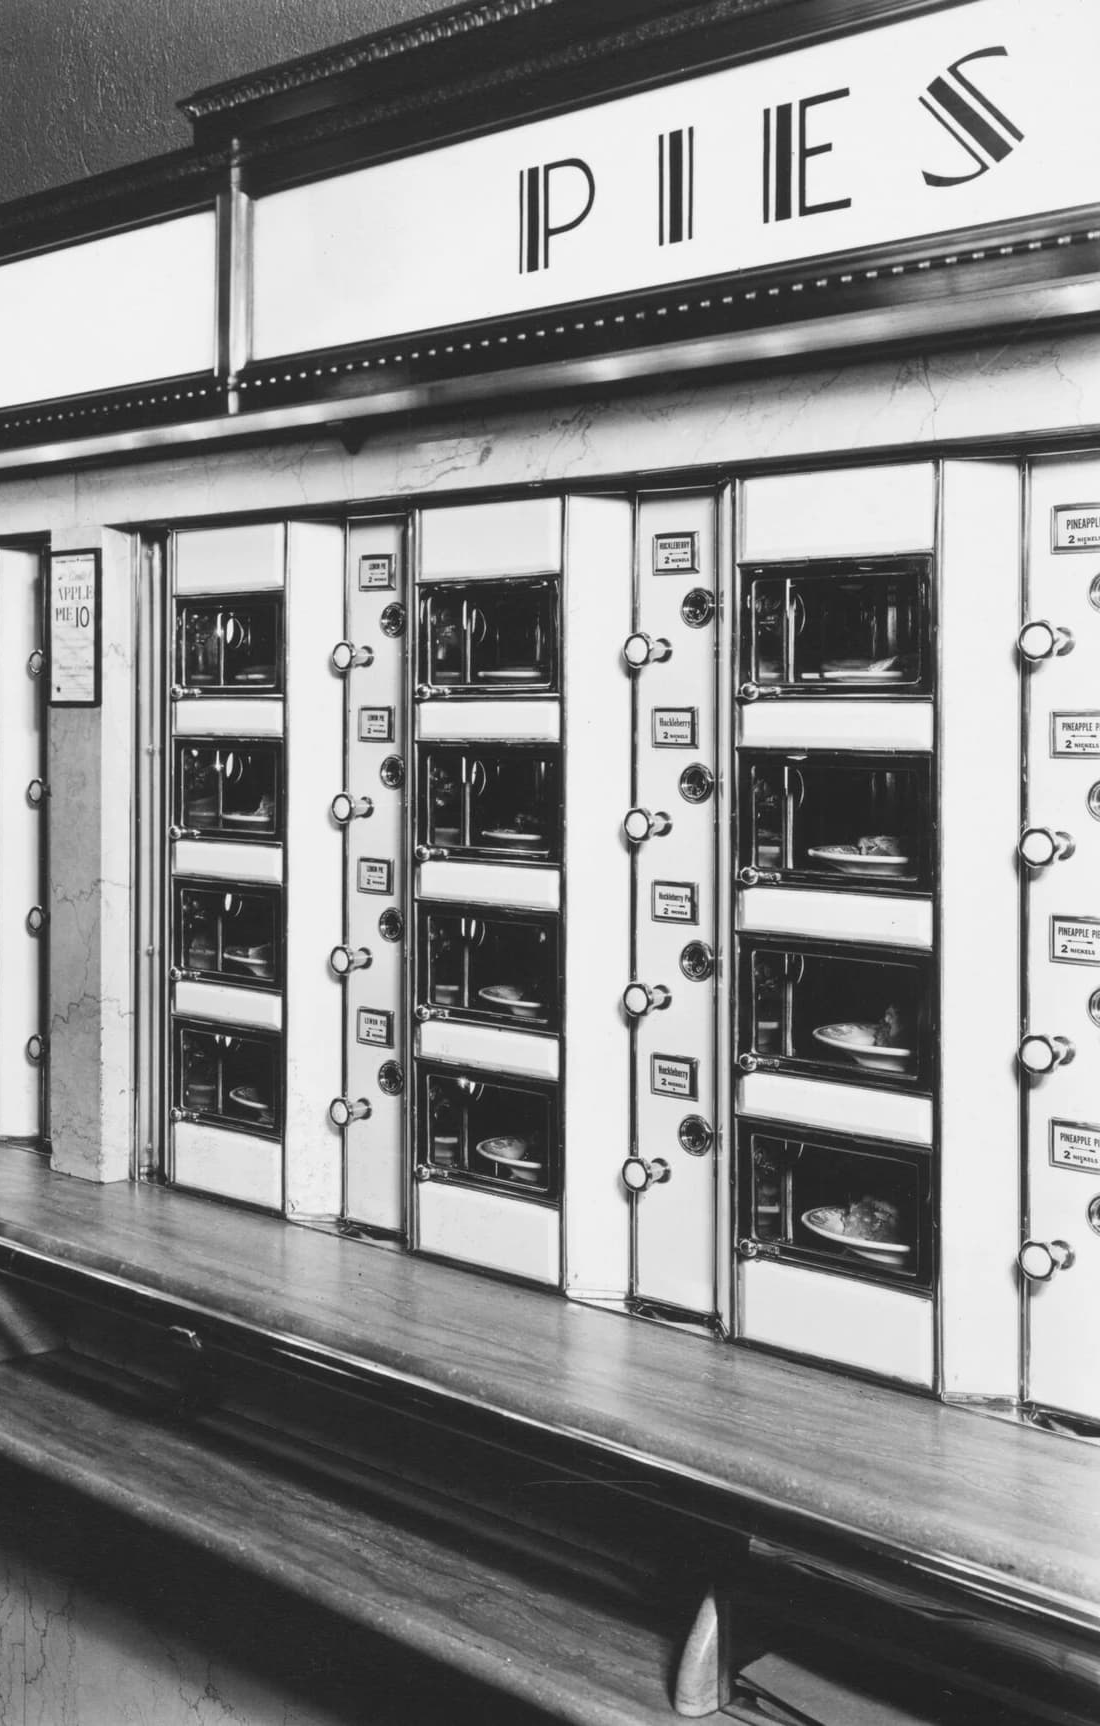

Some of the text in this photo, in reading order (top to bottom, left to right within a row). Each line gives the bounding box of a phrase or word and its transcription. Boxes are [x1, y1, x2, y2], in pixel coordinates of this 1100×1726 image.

[519, 45, 1026, 275] PIES
[1068, 534, 1075, 544] 2
[664, 556, 670, 564] 2
[58, 585, 93, 600] APPLE
[56, 606, 90, 628] PIE 10
[660, 717, 690, 728] Huckleberry
[1062, 722, 1092, 732] PINEAPPLE
[663, 731, 668, 739] 2
[1065, 740, 1072, 748] 2
[664, 907, 668, 915] 2
[1058, 926, 1090, 938] PINEAPPLE
[1061, 944, 1068, 954] 2
[658, 1064, 688, 1080] Huckleberry
[661, 1078, 667, 1086] 2
[1060, 1132, 1092, 1146] PINEAPPLE
[1064, 1150, 1098, 1164] 2 NICKELS
